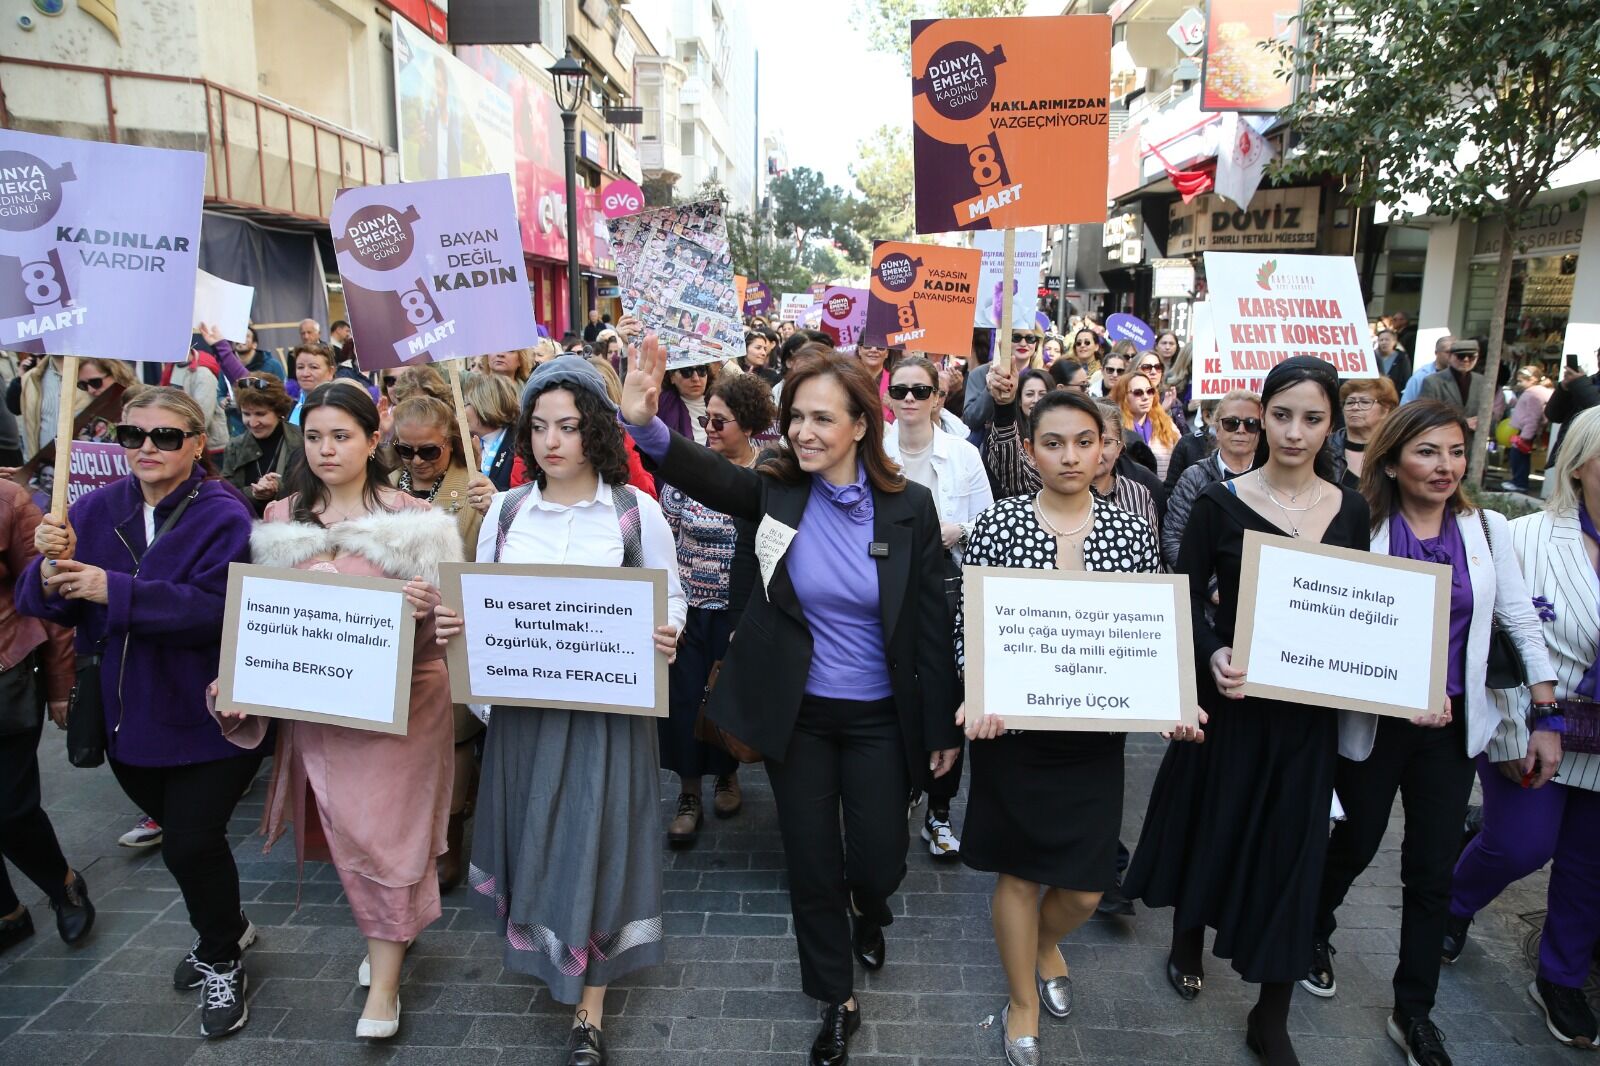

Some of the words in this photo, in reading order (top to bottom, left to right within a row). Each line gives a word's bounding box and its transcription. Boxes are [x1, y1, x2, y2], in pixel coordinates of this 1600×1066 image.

[928, 52, 982, 79] DÜNYA
[932, 63, 984, 92] EMEKÇİ
[936, 77, 988, 102] KADINLAR
[949, 91, 979, 108] GÜNÜ
[990, 97, 1106, 112] HAKLARIMIZDAN
[989, 113, 1107, 129] VAZGEÇMİYORUZ
[0, 165, 45, 181] NYA
[969, 144, 1001, 187] 8
[0, 192, 51, 206] DINLAR
[968, 184, 1022, 219] MART
[0, 203, 38, 217] GÜNÜ
[348, 213, 397, 239] DÜNYA
[354, 222, 402, 249] EMEKÇİ
[56, 226, 190, 252] KADINLAR
[360, 232, 407, 256] KADINLAR
[440, 229, 499, 248] BAYAN
[80, 249, 166, 272] VARDIR
[373, 245, 400, 261] GÜNÜ
[447, 247, 501, 268] DEĞİL,
[881, 258, 910, 270] DÜNYA
[882, 266, 911, 276] EMEKÇİ
[928, 269, 967, 280] YAŞASIN
[21, 260, 62, 306] 8
[433, 265, 518, 292] KADIN
[883, 271, 913, 281] KADINLAR
[924, 280, 970, 293] KADIN
[400, 289, 434, 326] 8
[913, 291, 975, 304] DAYANIŞMASI
[897, 305, 915, 328] 8
[1237, 297, 1342, 321] KARŞIYAKA
[17, 307, 87, 338] MART
[408, 320, 455, 354] MART
[894, 329, 925, 344] MART
[1230, 324, 1276, 343] KENT
[1280, 322, 1358, 345] KONSEYİ
[1231, 350, 1288, 370] KADIN
[1201, 379, 1246, 394] KADIN
[70, 448, 112, 479] GÜÇLÜ
[1292, 576, 1348, 597] Kadınsız
[1352, 586, 1395, 607] inkılap
[247, 597, 290, 616] İnsanın
[294, 606, 342, 624] yaşama,
[345, 611, 394, 630] hürriyet,
[484, 598, 504, 609] Bu
[508, 600, 551, 612] esaret
[555, 601, 633, 616] zincirinden
[995, 605, 1016, 616] Var
[1019, 606, 1072, 620] olmanın,
[1074, 609, 1110, 623] özgür
[1113, 612, 1164, 624] yaşamın
[1289, 598, 1345, 618] mümkün
[1349, 608, 1399, 627] değildir
[246, 620, 298, 636] özgürlük
[302, 625, 333, 641] hakkı
[336, 631, 391, 648] olmalıdır.
[515, 618, 603, 633] kurtulmak!...
[999, 623, 1025, 636] yolu
[1028, 625, 1058, 639] çağa
[1061, 628, 1105, 641] uymayı
[1108, 628, 1162, 640] bilenlere
[485, 633, 552, 651] Özgürlük,
[555, 639, 635, 655] özgürlük!...
[1003, 641, 1037, 655] açılır.
[1040, 643, 1057, 654] Bu
[1061, 643, 1076, 655] da
[1079, 644, 1105, 656] milli
[1108, 645, 1158, 659] eğitimle
[245, 655, 289, 671] Semiha
[292, 661, 354, 680] BERKSOY
[486, 665, 528, 678] Selma
[532, 667, 562, 679] Rıza
[566, 669, 637, 685] FERACELİ
[1054, 662, 1107, 676] sağlanır.
[1280, 650, 1325, 669] Nezihe
[1328, 658, 1398, 681] MUHİDDİN
[1026, 693, 1082, 709] Bahriye
[1085, 692, 1130, 711] ÜÇOK
